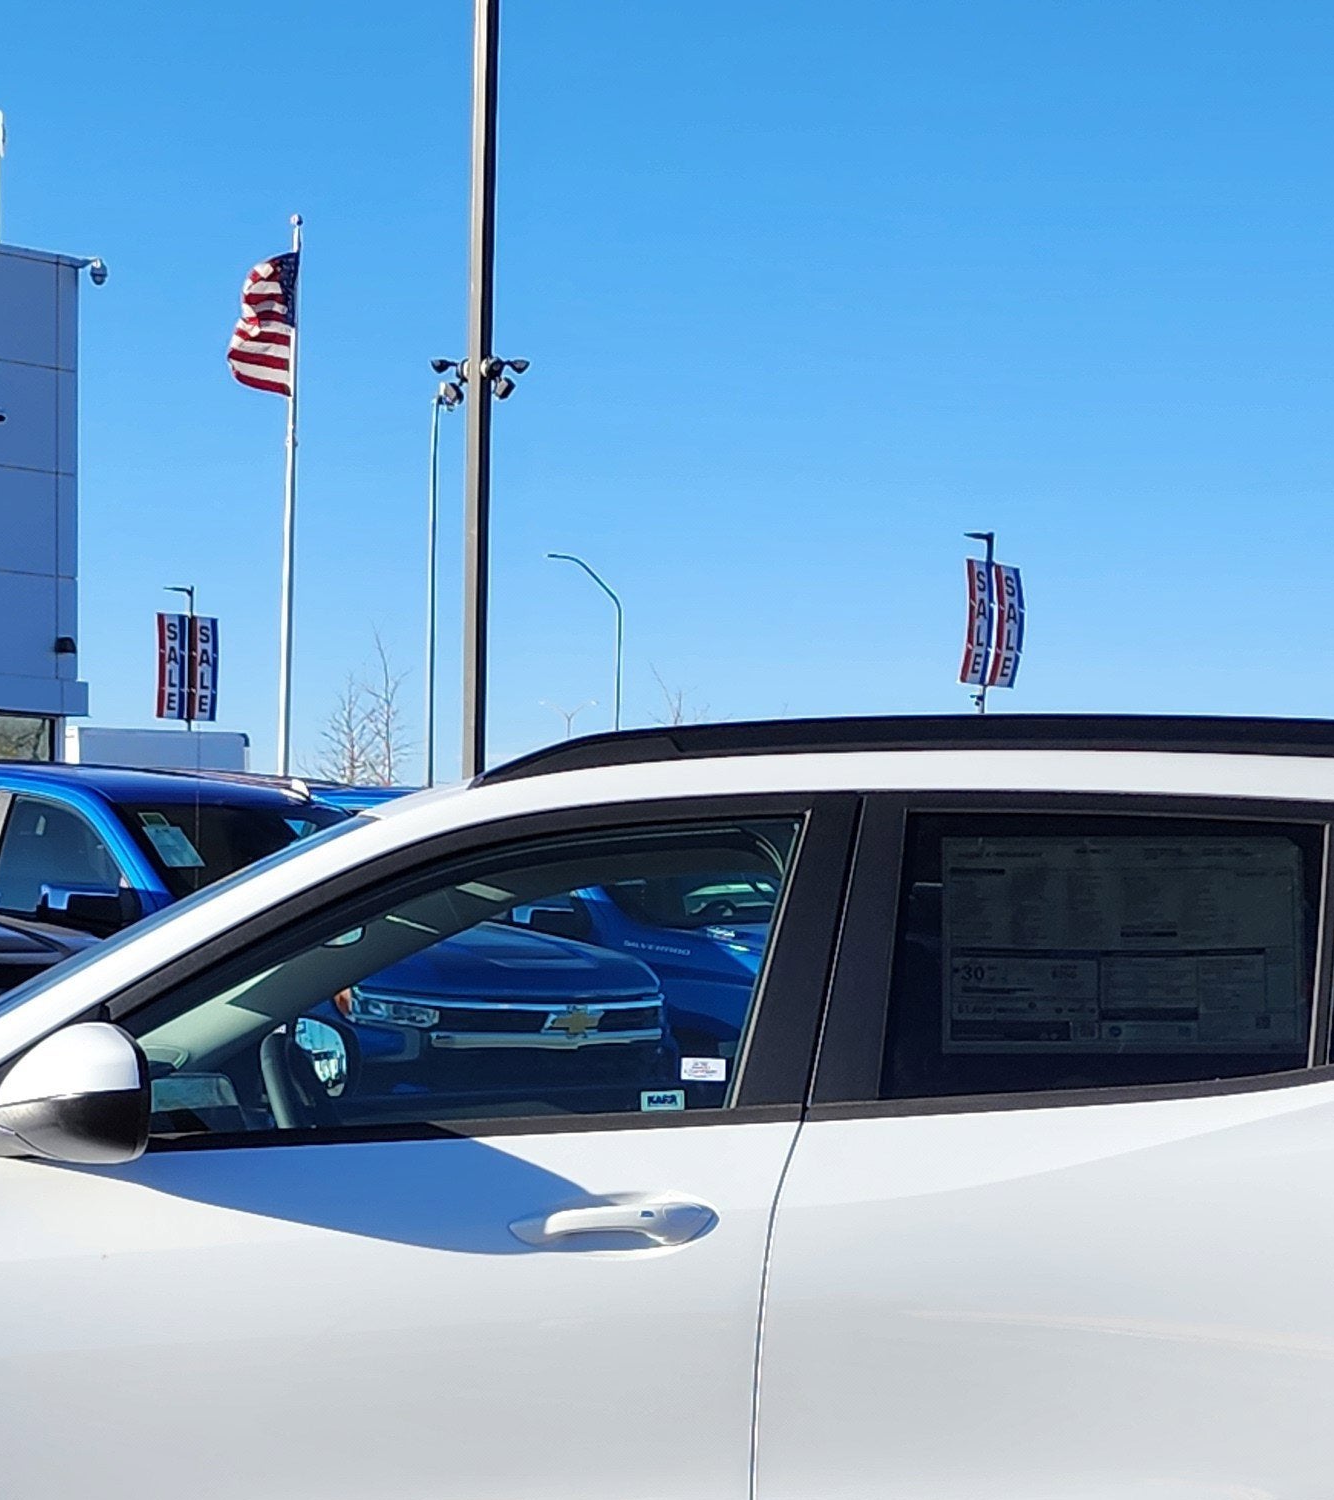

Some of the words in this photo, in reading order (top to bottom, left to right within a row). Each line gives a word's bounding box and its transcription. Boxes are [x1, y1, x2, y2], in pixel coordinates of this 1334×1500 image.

[166, 622, 179, 712] SALE
[197, 625, 212, 714] SALE
[970, 570, 987, 675] SALE
[999, 574, 1018, 678] SALE
